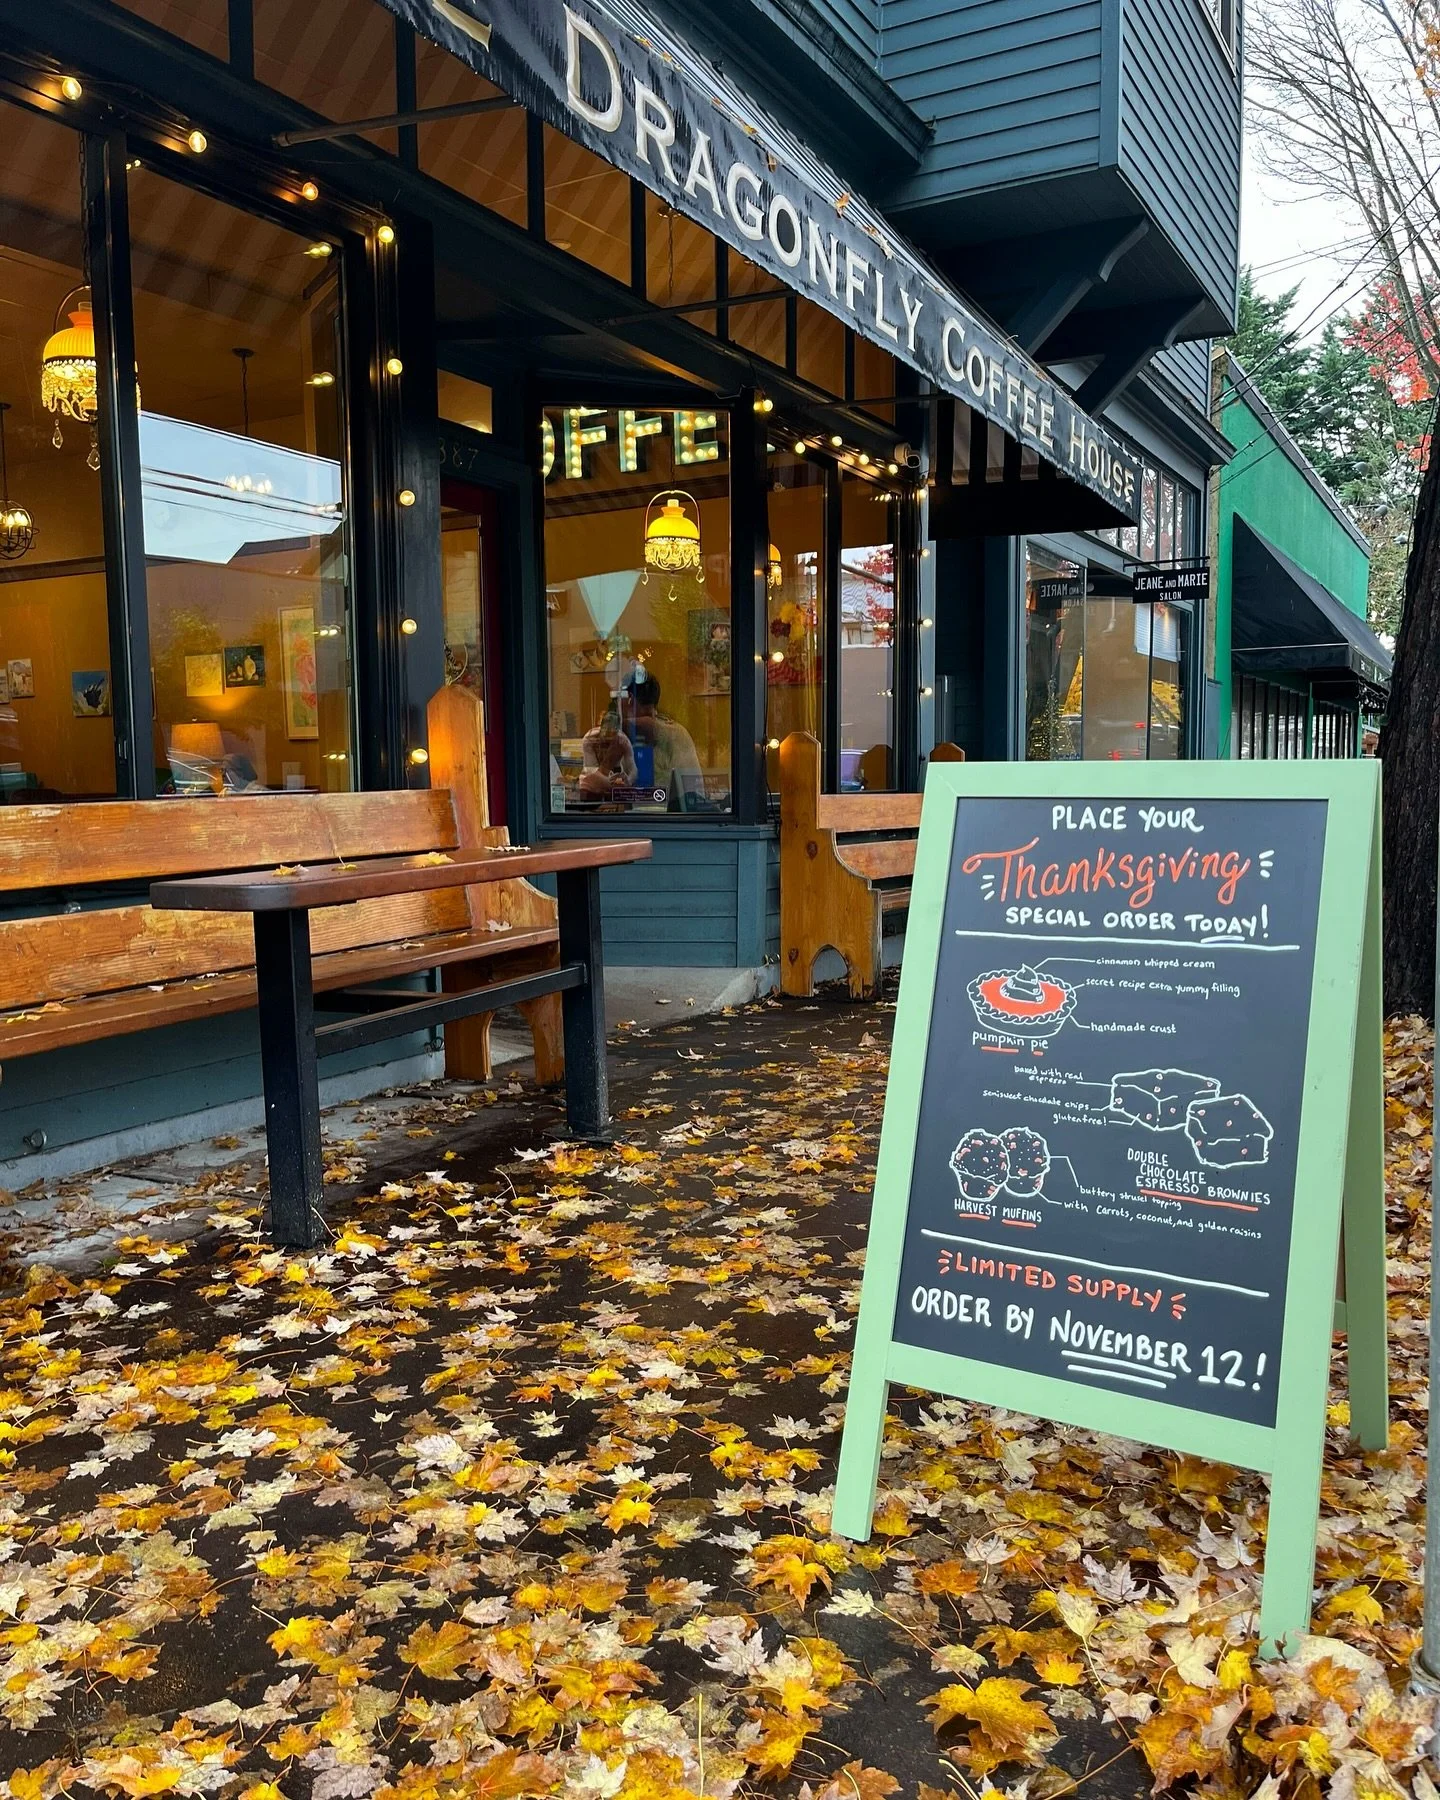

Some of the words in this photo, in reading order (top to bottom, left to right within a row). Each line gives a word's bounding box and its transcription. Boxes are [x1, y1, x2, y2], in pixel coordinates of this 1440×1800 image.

[562, 3, 923, 353] DRAGONFLY
[942, 315, 1055, 449] COFFEE
[1068, 414, 1135, 504] HOUSE
[1135, 576, 1164, 590] JEANE
[1165, 579, 1177, 588] AND
[1178, 572, 1208, 588] MARIE
[1159, 591, 1182, 601] SALON
[1052, 805, 1127, 830] PLACE
[1138, 807, 1204, 832] YOUR
[962, 836, 1251, 909] Thanksgiving
[1005, 907, 1091, 928] SPECIAL
[1103, 912, 1176, 931] ORDER
[1184, 904, 1269, 939] TODAY!
[1096, 957, 1141, 966] cinnamon
[1144, 957, 1179, 969] whipped
[1183, 960, 1215, 969] cream
[1086, 977, 1115, 987] secret
[1119, 979, 1146, 991] recipe
[1149, 981, 1173, 991] extra
[1175, 985, 1209, 1000] yummy
[1211, 982, 1240, 998] filling
[1090, 1022, 1146, 1032] handmade
[1150, 1023, 1177, 1034] crust
[972, 1031, 1025, 1049] pumpkin
[1030, 1038, 1049, 1052] pie
[1040, 1068, 1062, 1078] with
[1064, 1072, 1083, 1081] real
[1065, 1101, 1089, 1111] chips
[1127, 1147, 1169, 1167] DOUBLE
[1140, 1163, 1207, 1185] CHOCOLATE
[1080, 1185, 1116, 1202] buttery
[1152, 1197, 1182, 1211] topping
[1135, 1175, 1200, 1194] ESPRESSO
[1207, 1186, 1271, 1205] BROWNIES
[954, 1198, 998, 1217] HARVEST
[1002, 1207, 1042, 1223] MUFFINS
[1064, 1200, 1089, 1212] with
[1198, 1220, 1228, 1233] golden
[1229, 1227, 1262, 1239] raisins
[955, 1252, 1056, 1289] LIMITED
[1067, 1275, 1162, 1313] SUPPLY
[911, 1285, 992, 1328] ORDER
[1005, 1304, 1035, 1340] BY
[1050, 1309, 1192, 1374] NOVEMBER
[1198, 1345, 1267, 1391] 12!
